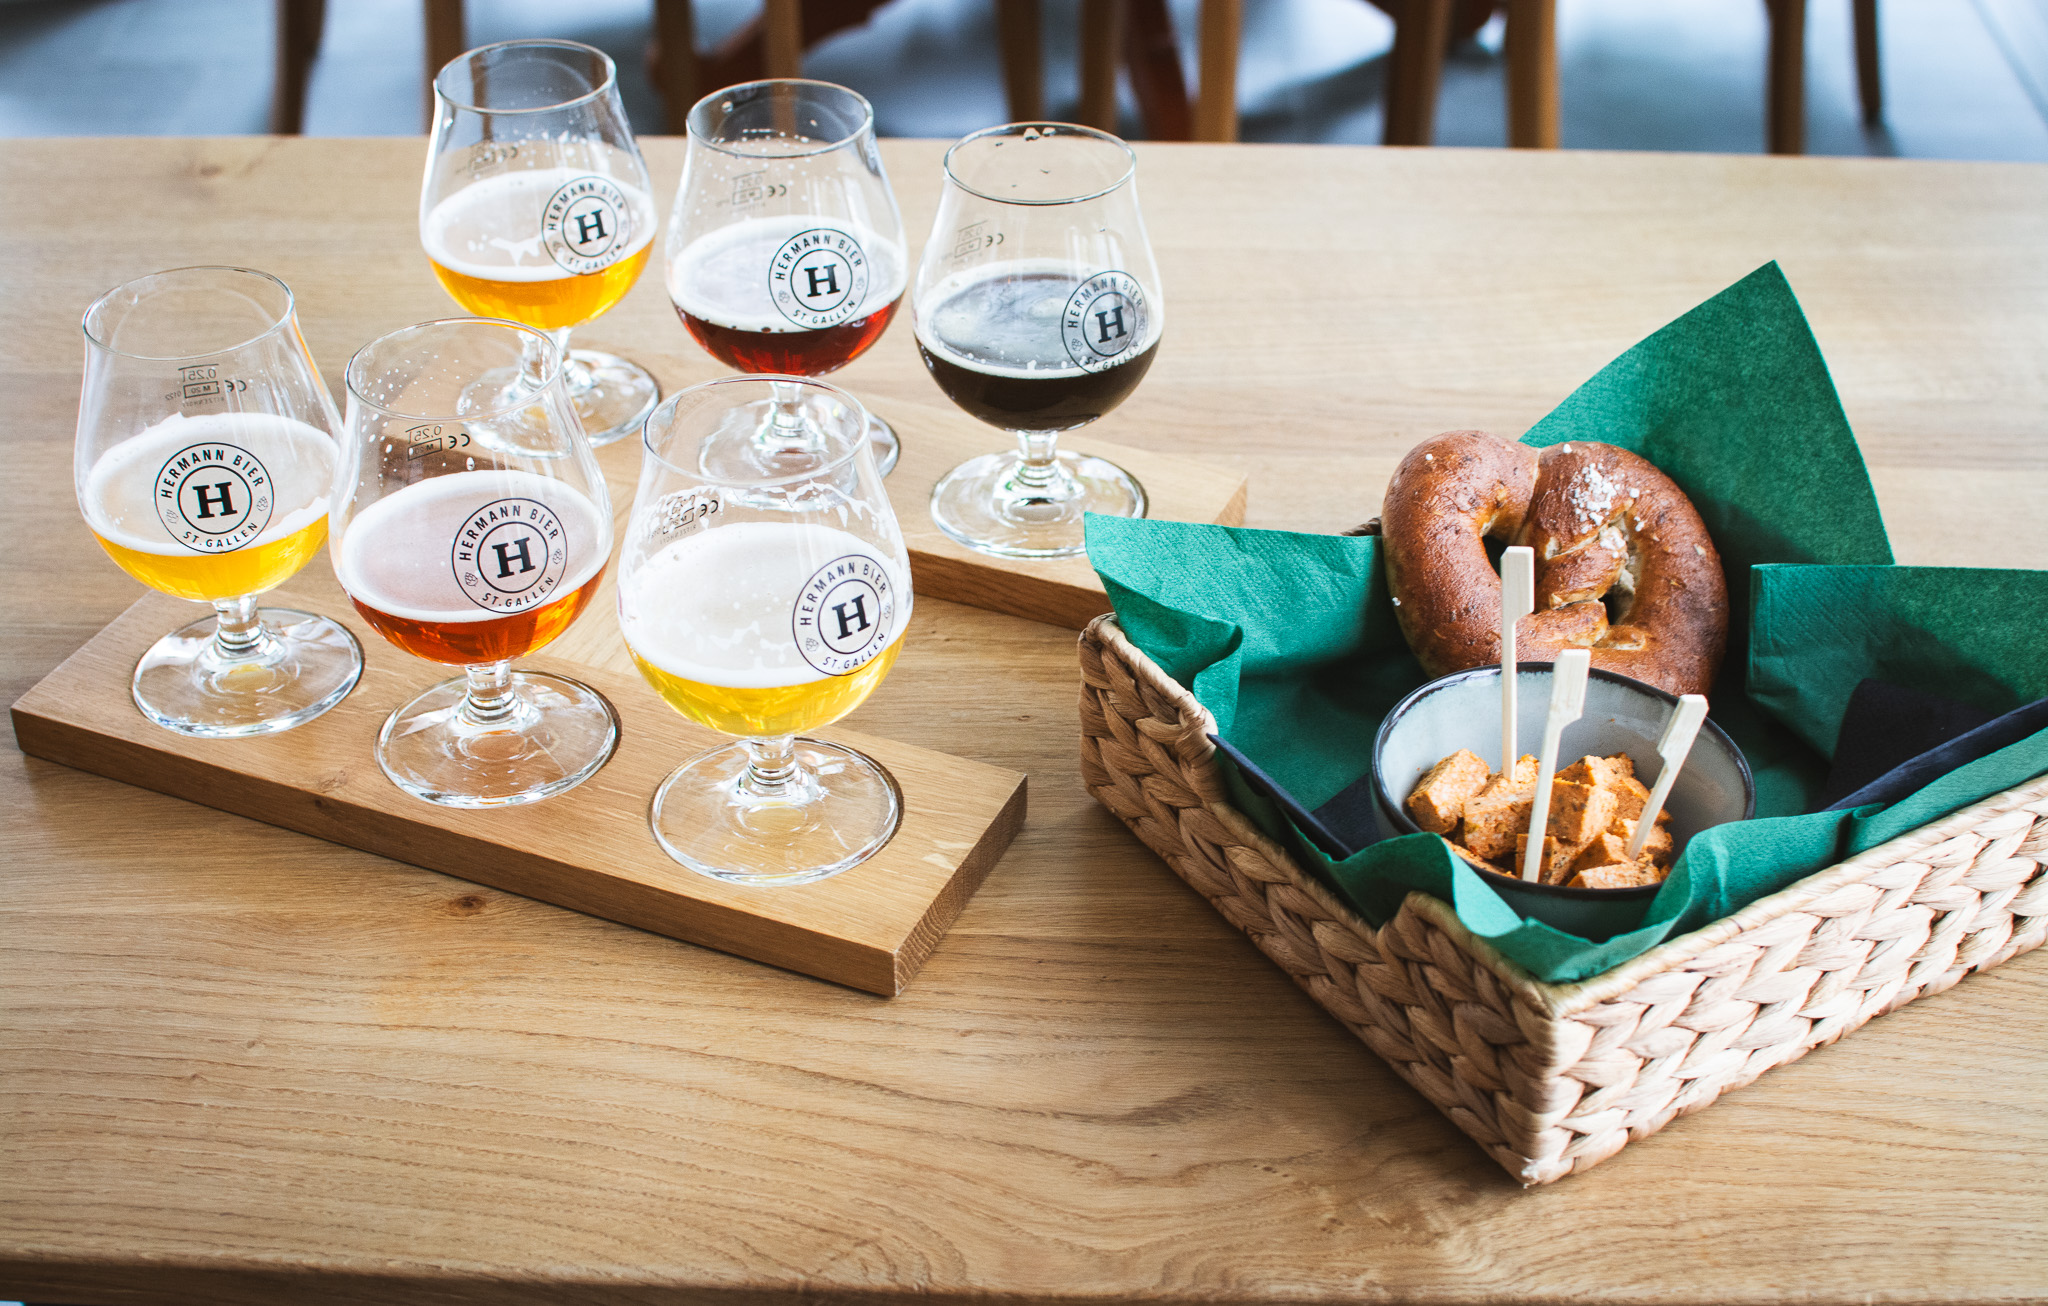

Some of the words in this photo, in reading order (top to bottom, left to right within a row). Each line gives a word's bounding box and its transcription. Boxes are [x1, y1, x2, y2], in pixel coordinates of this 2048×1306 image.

[548, 182, 595, 231] HERMANN
[601, 185, 624, 210] BIER
[574, 209, 608, 245] H
[775, 234, 831, 281] HERMANN
[838, 238, 862, 267] BIER
[804, 263, 841, 298] H
[1067, 276, 1117, 329] HERMANN
[1123, 280, 1143, 308] BIER
[1095, 305, 1128, 344] H
[160, 449, 225, 499] HERMANN
[232, 454, 265, 488] BIER
[191, 481, 239, 520] H
[458, 505, 521, 561] HERMANN
[529, 508, 559, 540] BIER
[491, 536, 536, 579] H
[799, 562, 856, 626] HERMANN
[863, 563, 887, 594] BIER
[831, 593, 871, 641] H
